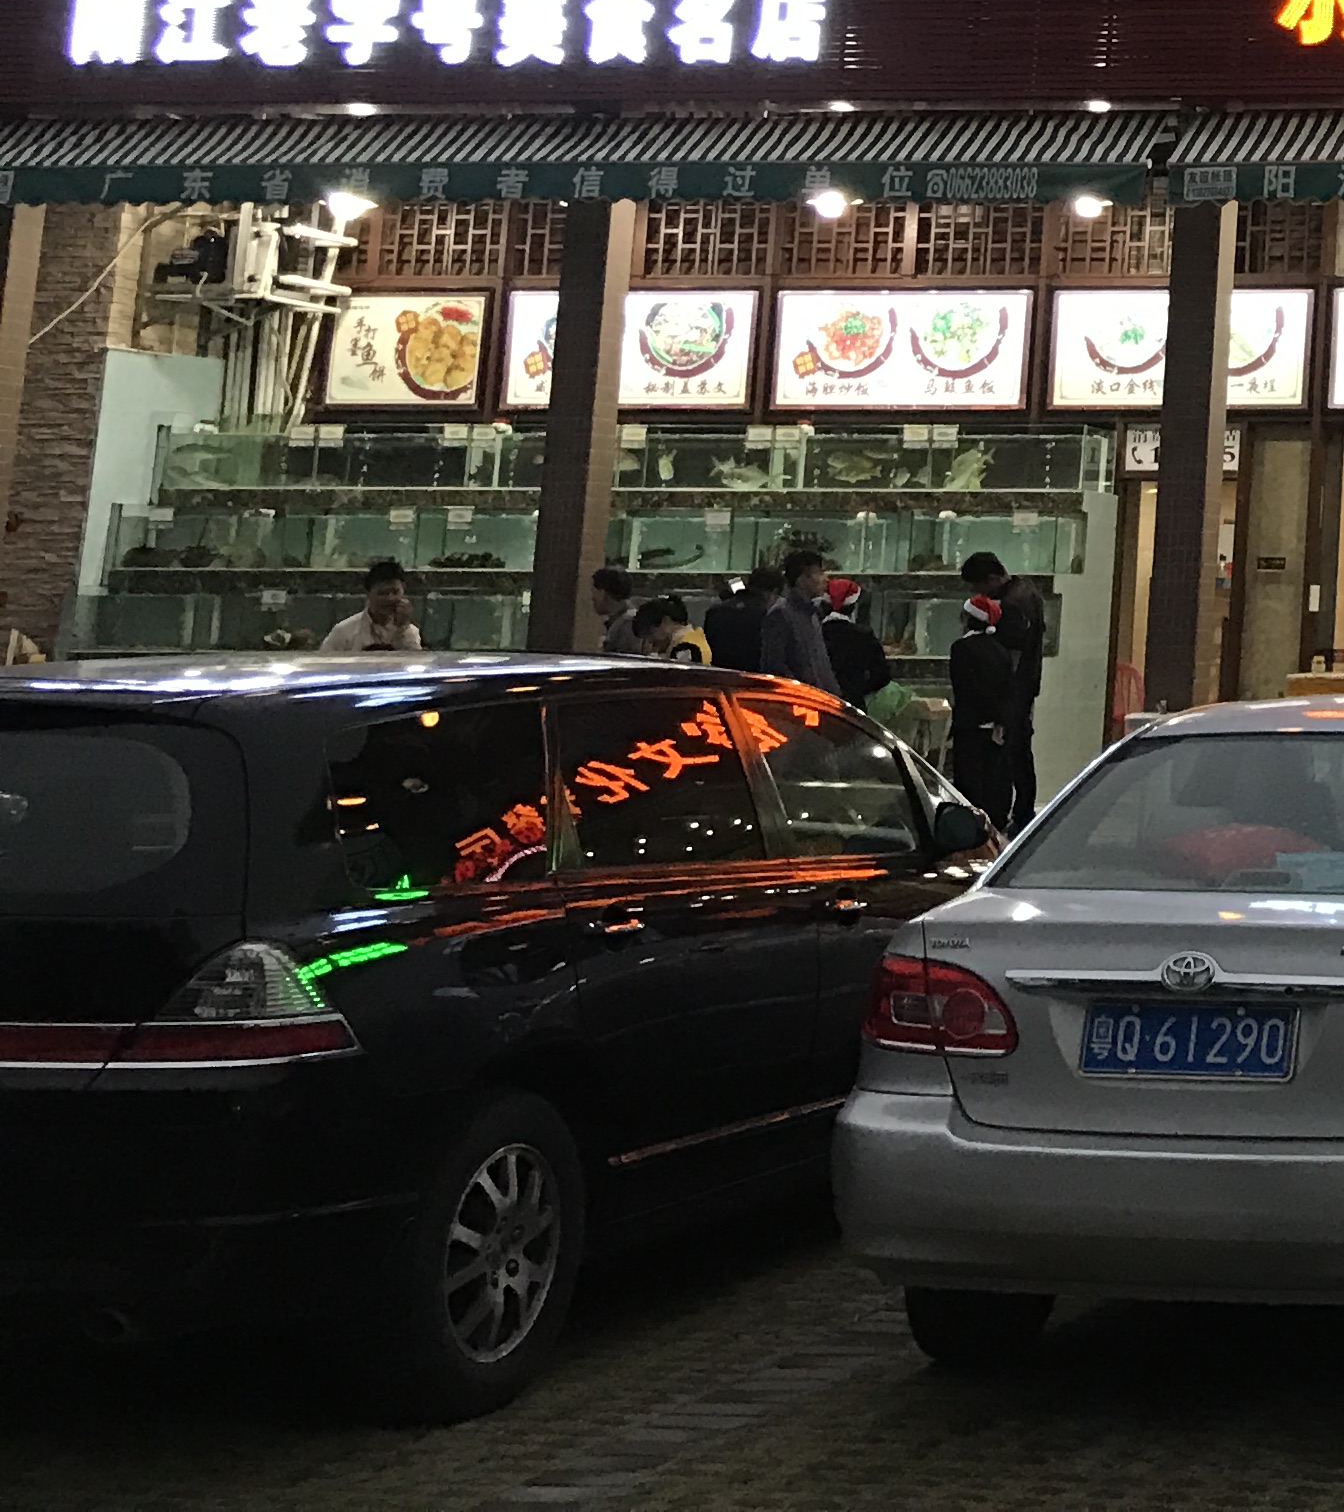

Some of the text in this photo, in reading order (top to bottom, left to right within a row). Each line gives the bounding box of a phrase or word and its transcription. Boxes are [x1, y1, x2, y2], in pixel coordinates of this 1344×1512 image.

[100, 166, 912, 201] 广东省消费者信得过单位
